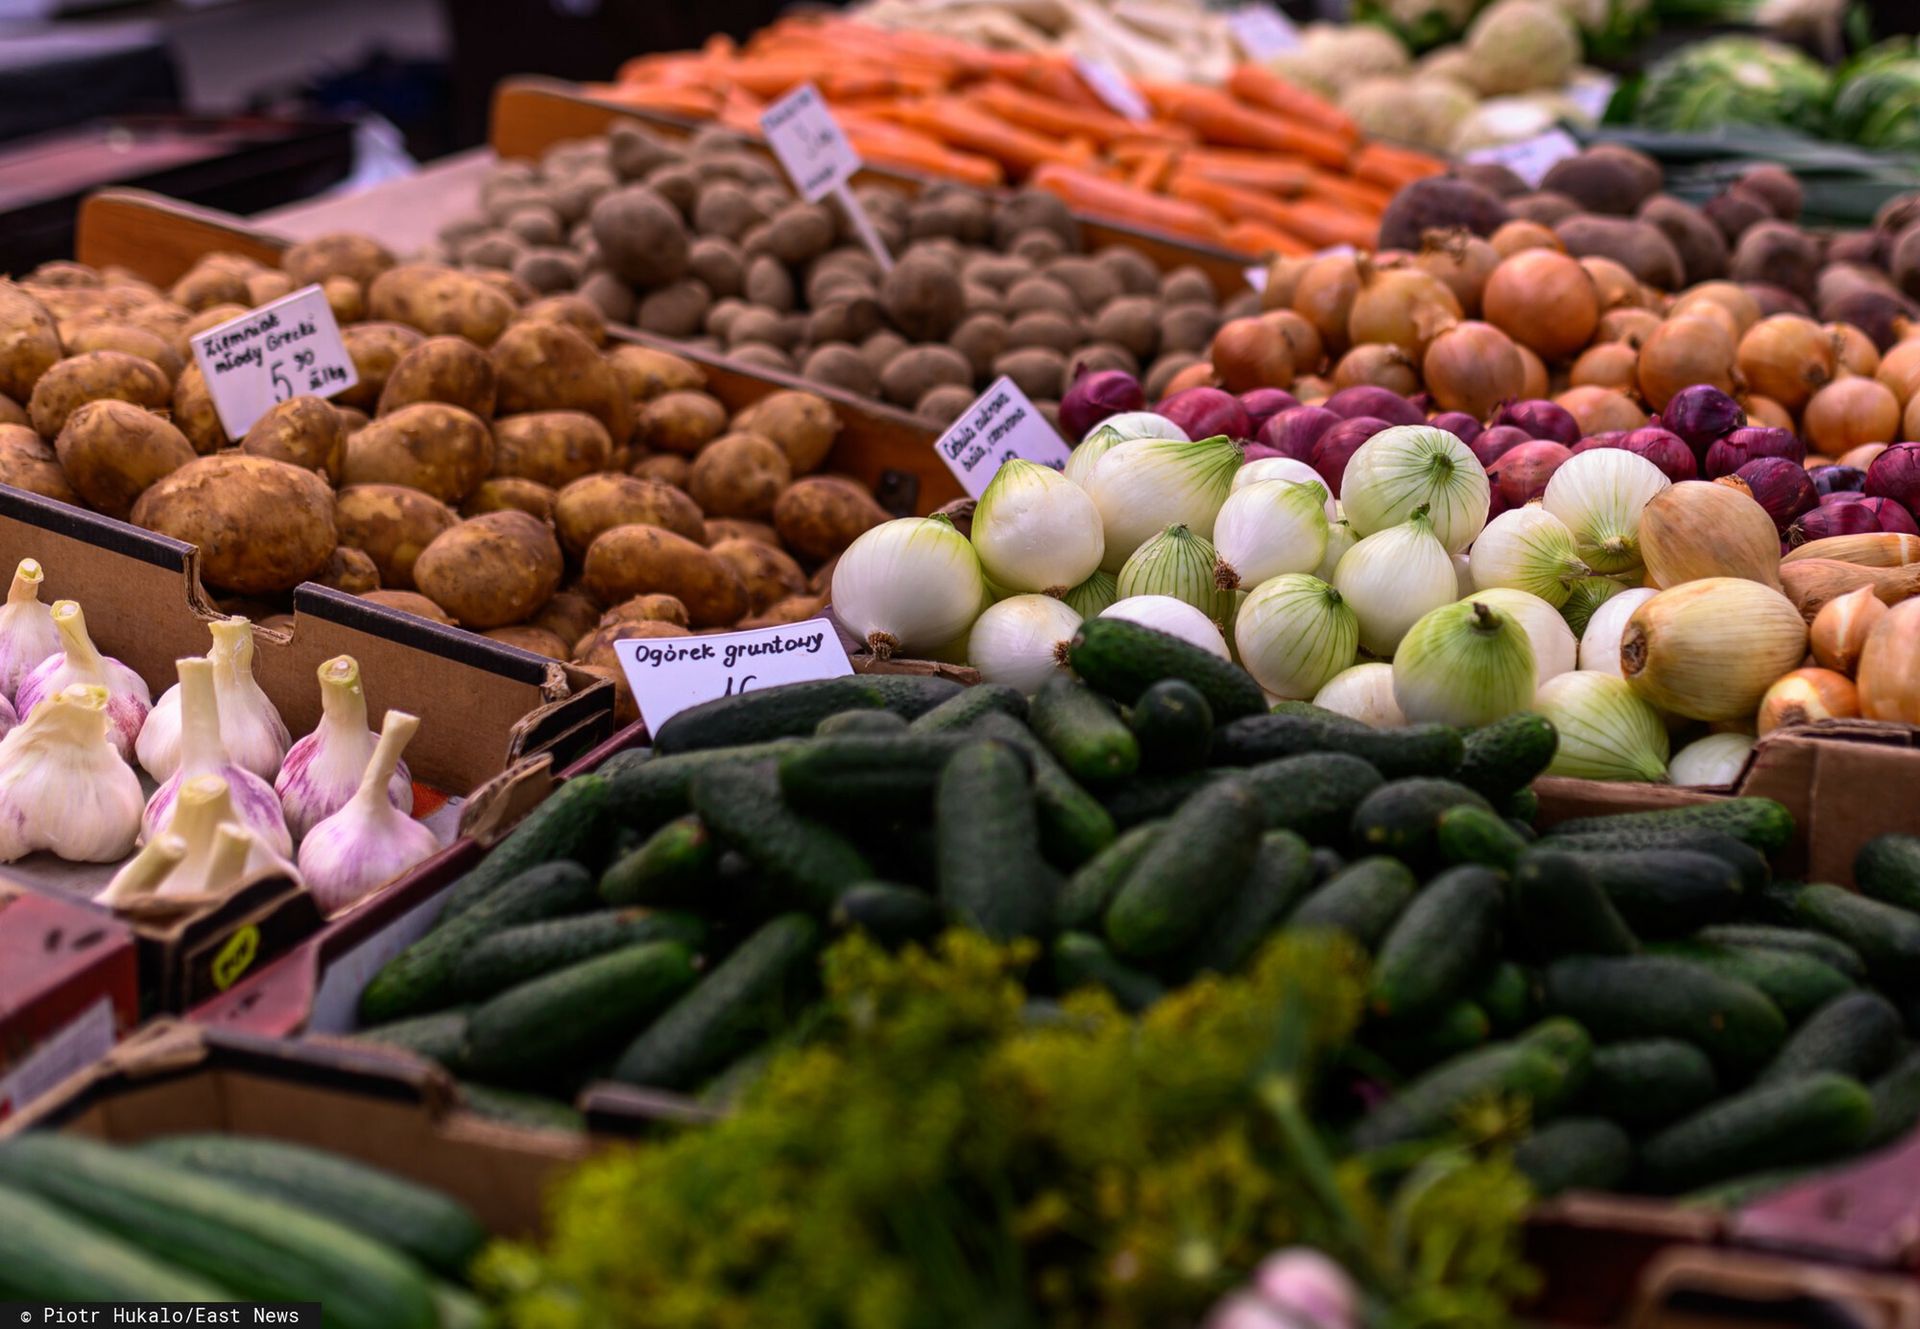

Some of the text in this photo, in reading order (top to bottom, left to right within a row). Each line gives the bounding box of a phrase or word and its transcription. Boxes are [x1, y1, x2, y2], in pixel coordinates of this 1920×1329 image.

[203, 313, 280, 358] Ziemniak
[214, 313, 317, 375] młody Grecki
[270, 360, 293, 403] 5
[723, 632, 824, 668] gruntowy
